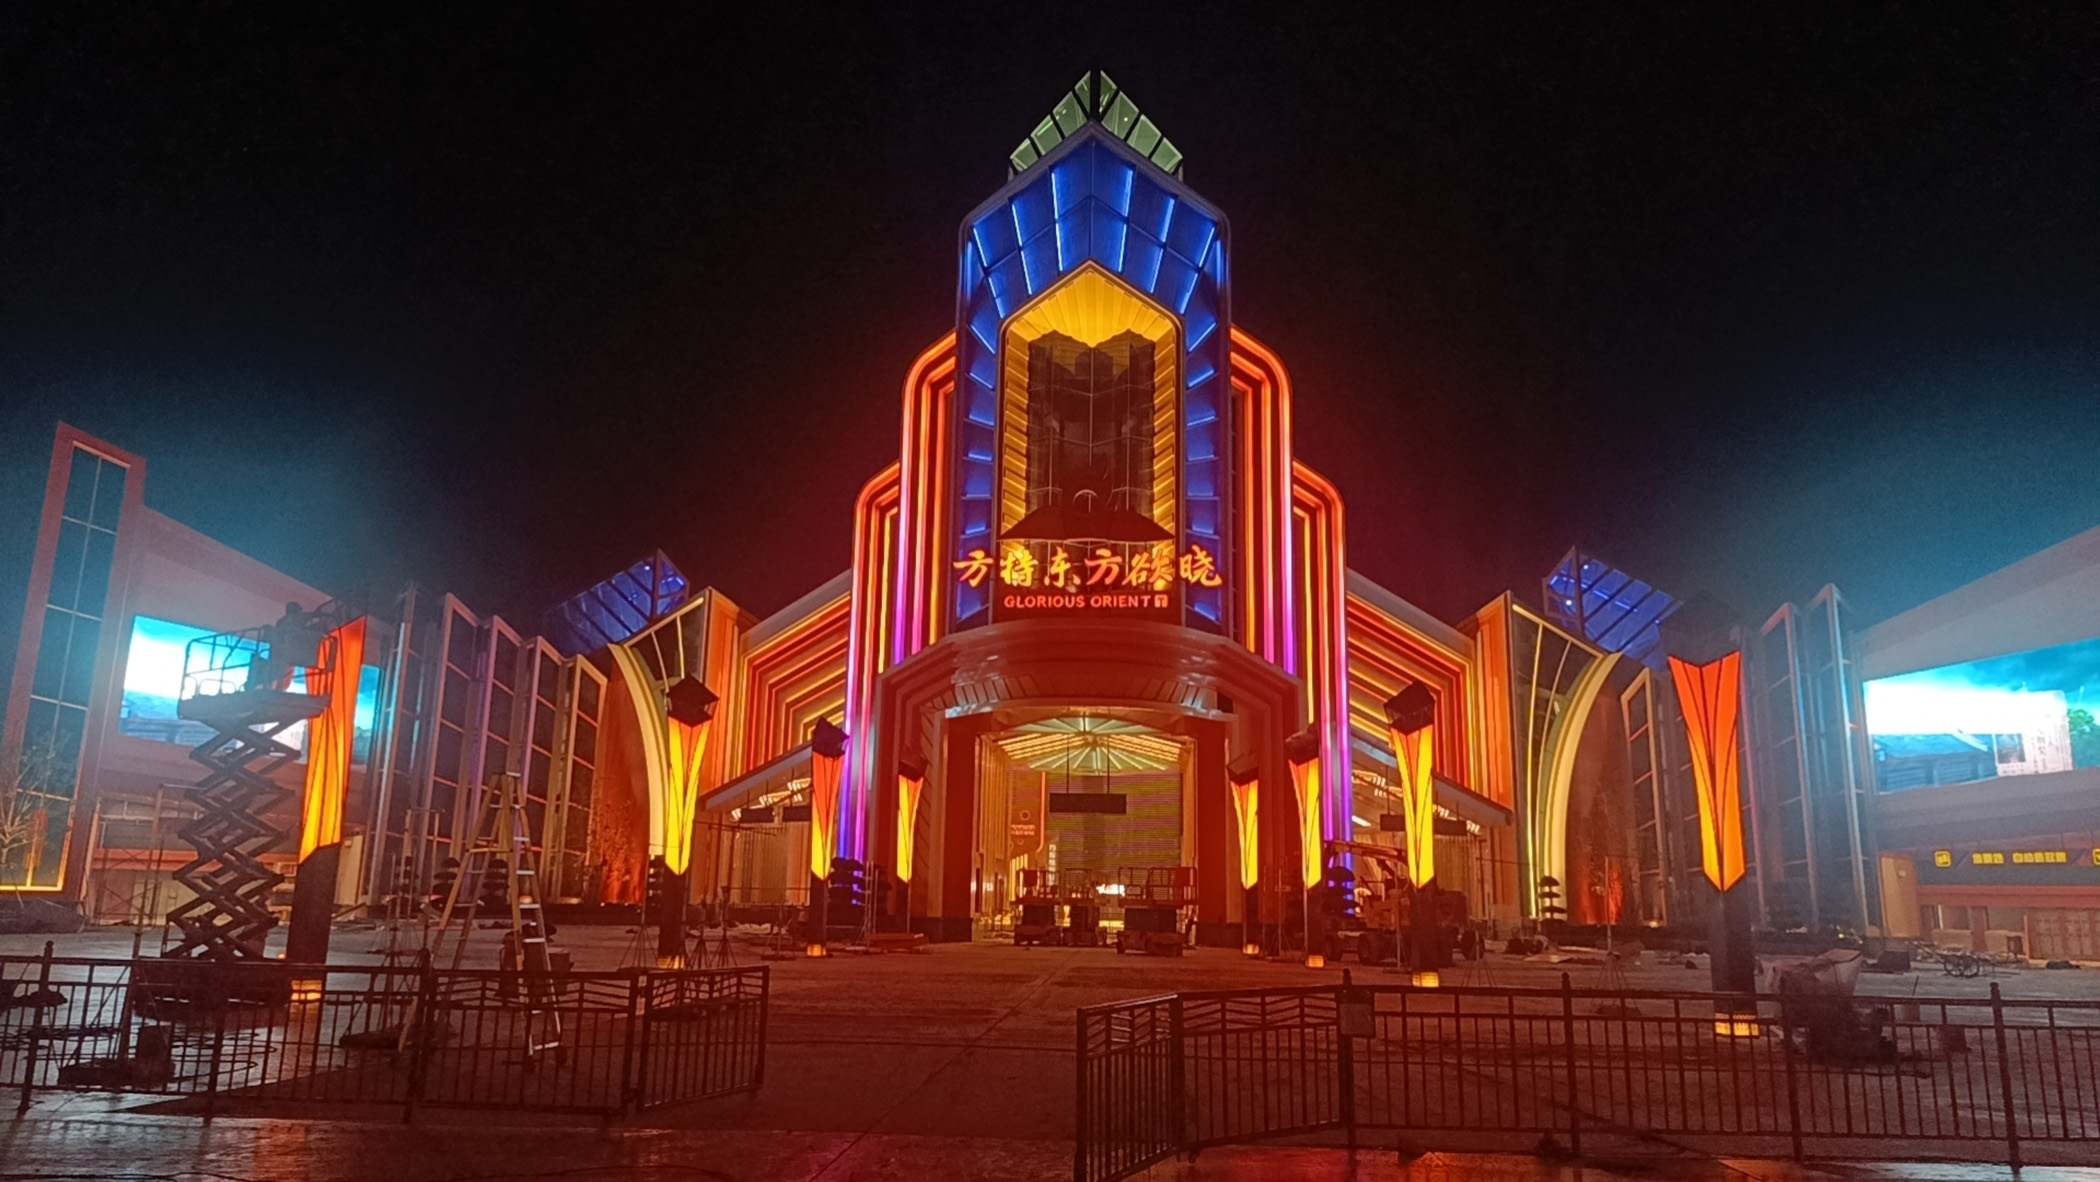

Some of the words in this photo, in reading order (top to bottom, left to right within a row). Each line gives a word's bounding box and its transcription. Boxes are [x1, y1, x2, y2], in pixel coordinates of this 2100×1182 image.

[953, 545, 1222, 588] 方特东方欲晓
[1003, 594, 1085, 608] GLORIOUS
[1090, 594, 1151, 608] ORIENT
